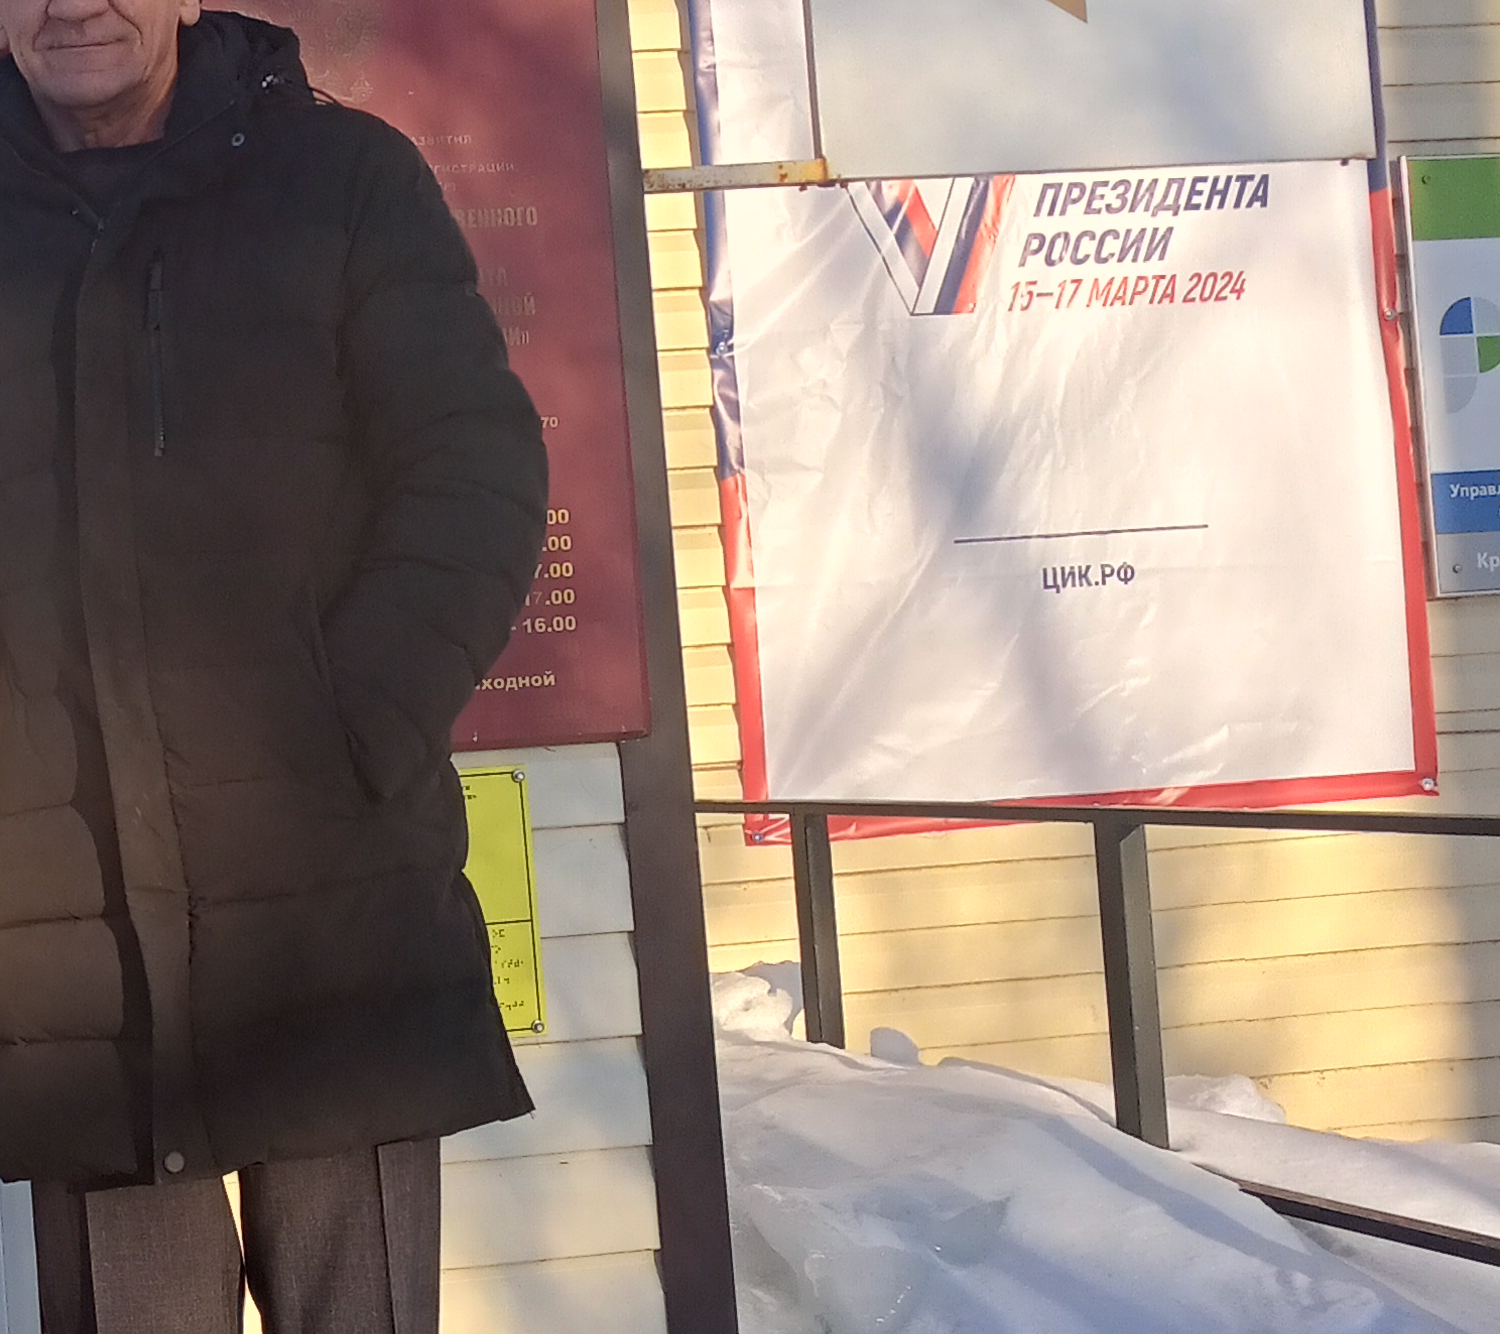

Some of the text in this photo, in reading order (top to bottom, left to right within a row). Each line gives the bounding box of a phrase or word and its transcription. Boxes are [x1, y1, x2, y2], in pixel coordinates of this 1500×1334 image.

[1033, 173, 1270, 218] ПРЕЗИДЕНТА
[1018, 226, 1175, 267] РОССИИ
[1084, 273, 1177, 309] МАРТА
[1182, 270, 1247, 305] 2024
[1041, 561, 1136, 595] ЦИК.РФ
[522, 615, 577, 634] 16.00
